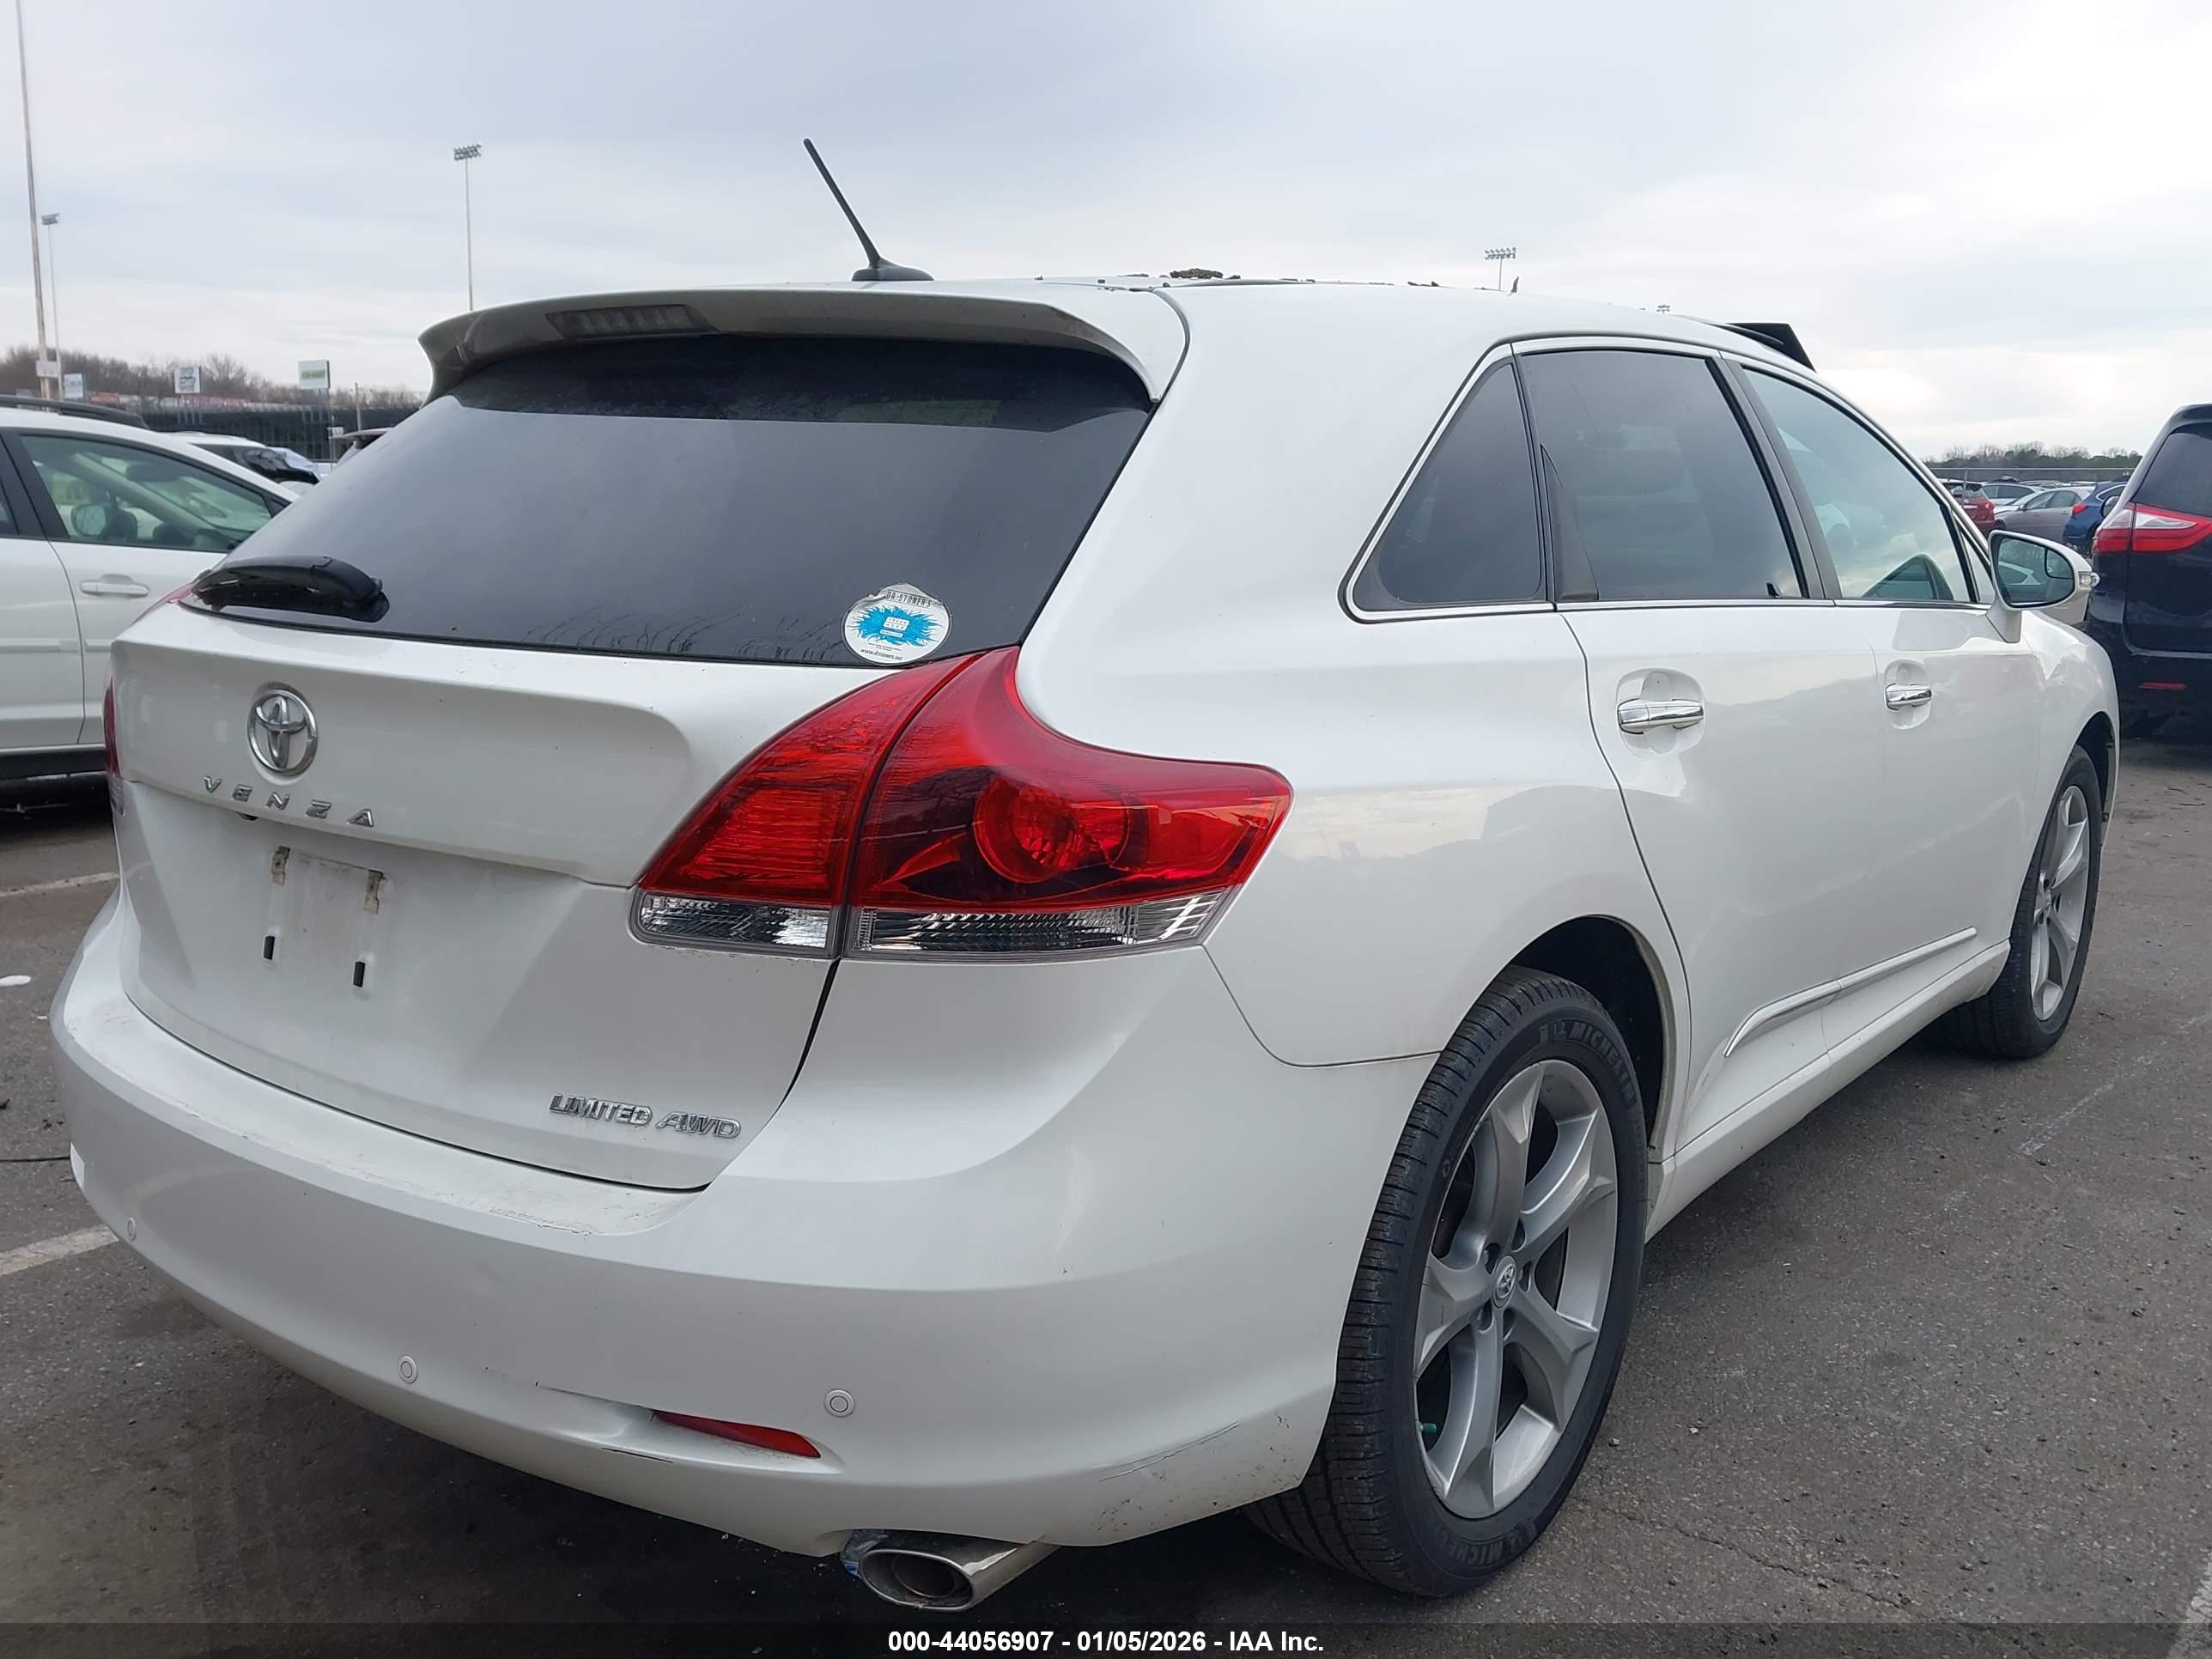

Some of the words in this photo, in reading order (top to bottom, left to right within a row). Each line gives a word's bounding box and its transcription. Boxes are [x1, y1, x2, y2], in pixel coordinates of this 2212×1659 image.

[204, 776, 374, 828] VENZA
[1569, 1022, 1635, 1103] MICHELIN
[549, 1093, 653, 1126] LIMITED
[656, 1112, 741, 1139] AWD
